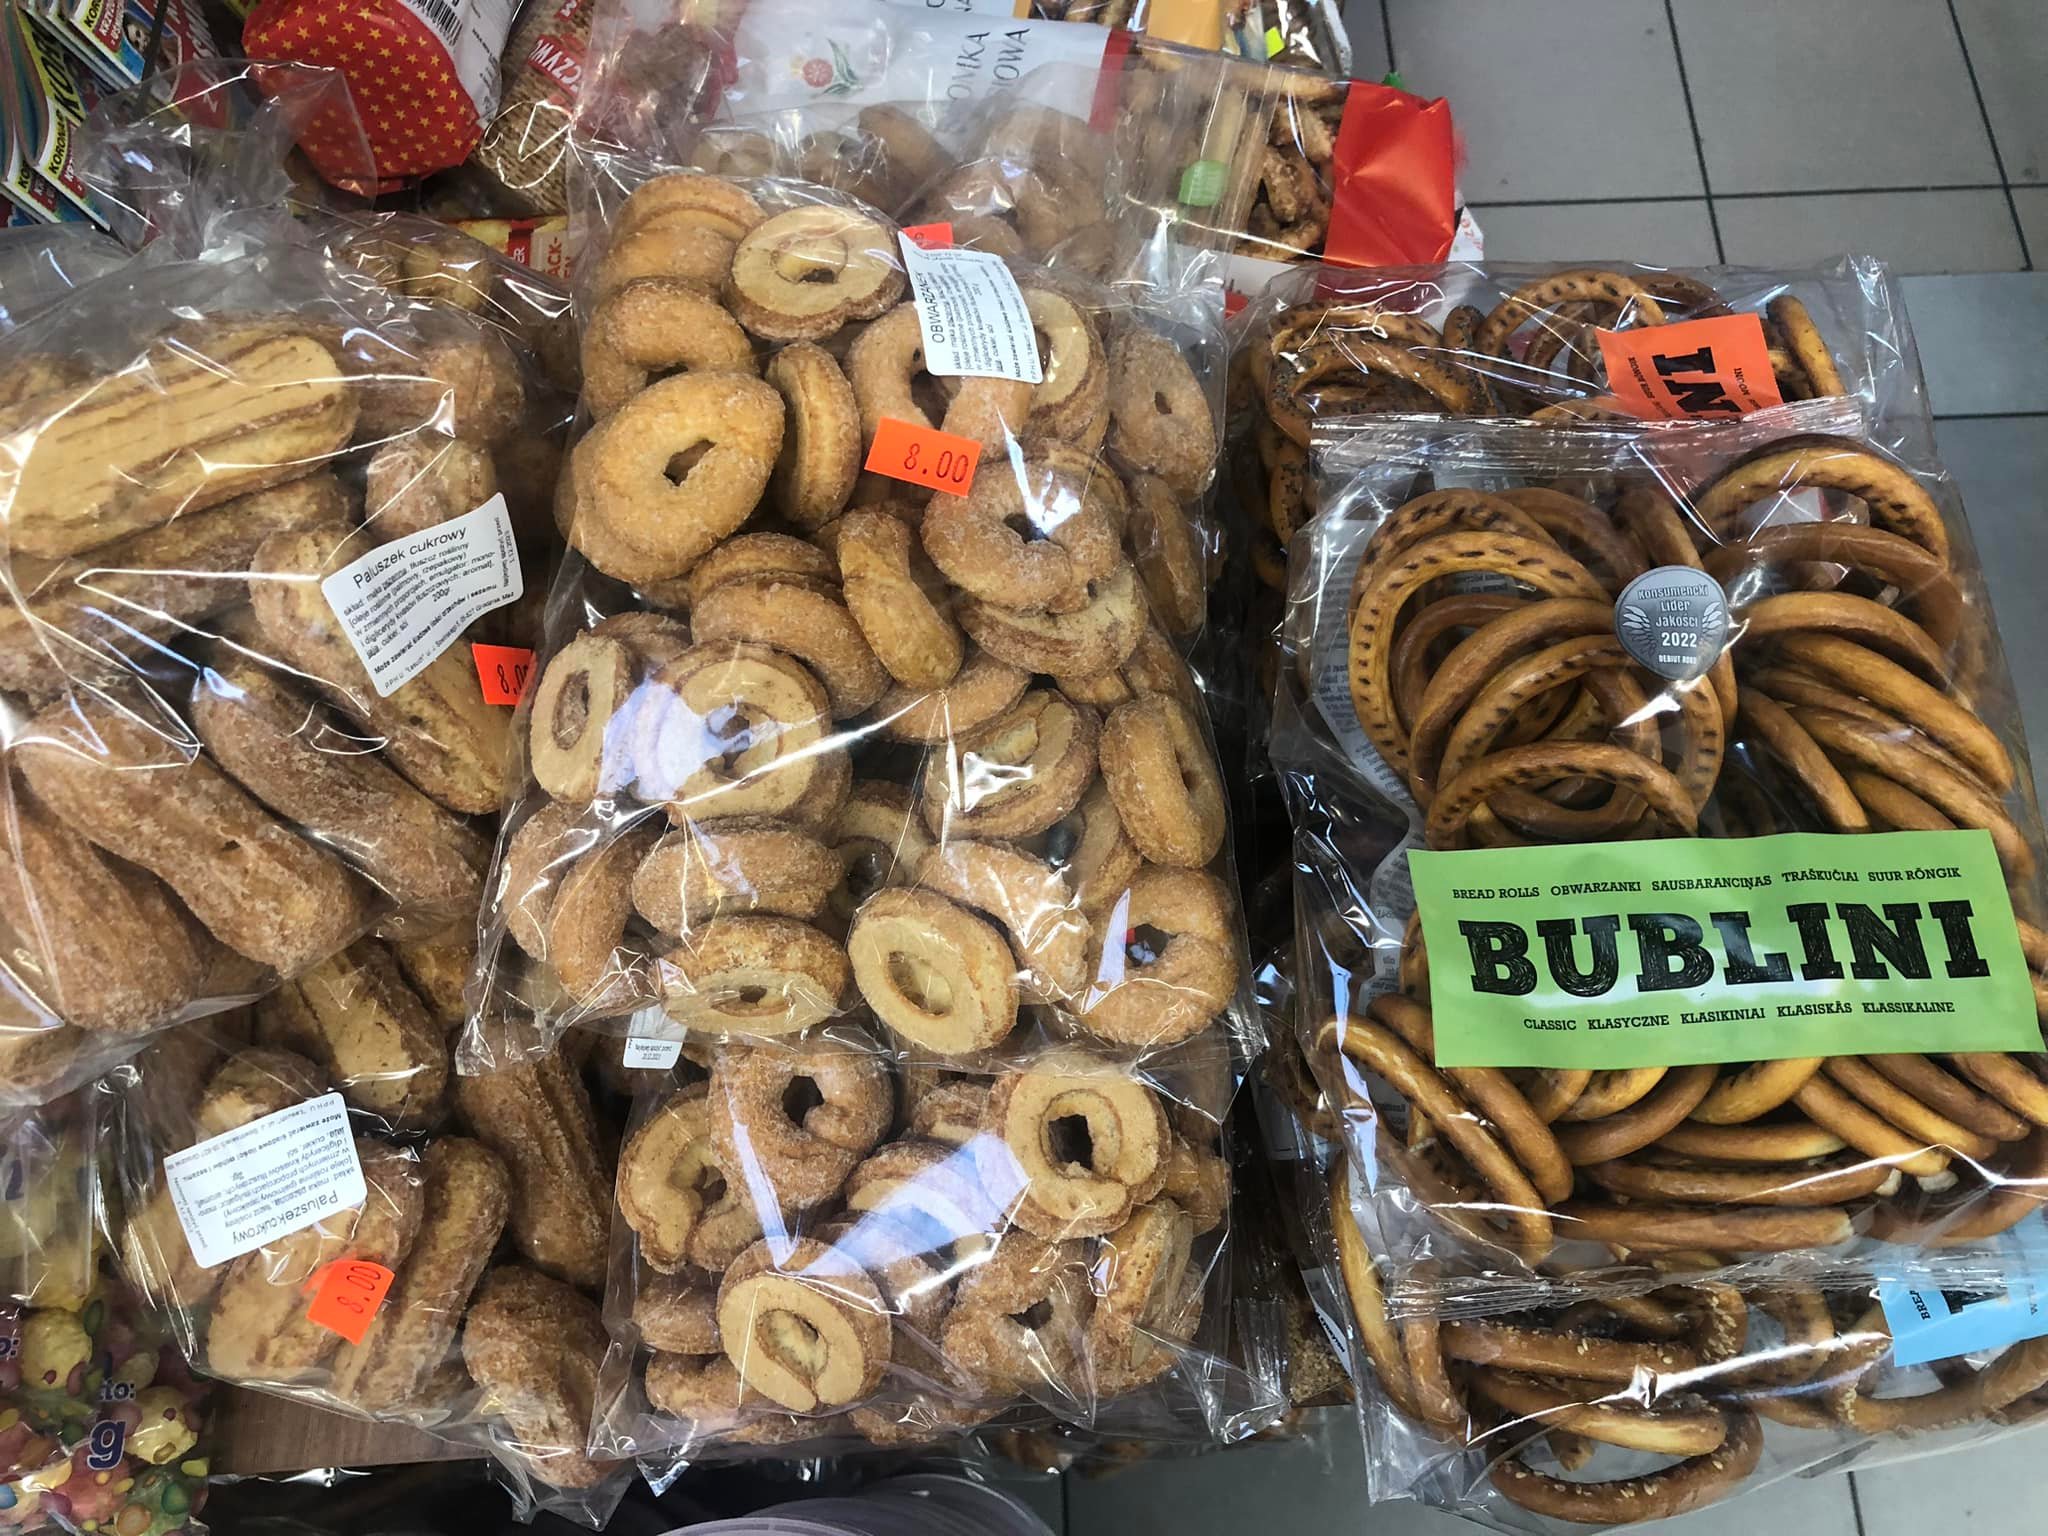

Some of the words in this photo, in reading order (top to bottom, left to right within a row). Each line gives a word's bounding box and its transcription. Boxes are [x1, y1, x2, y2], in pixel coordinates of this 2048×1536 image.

[904, 443, 969, 484] 8.00
[353, 549, 406, 589] Paluszek
[410, 527, 467, 555] cukrowy
[1661, 632, 1698, 648] 2022
[1452, 888, 1495, 900] BREAD
[1498, 886, 1541, 899] ROLLS
[1550, 881, 1642, 897] OBWARZANKI
[1781, 868, 1860, 883] TRAŠKUČIAI
[1868, 870, 1904, 882] SUUR
[1458, 900, 1991, 998] BUBLINI
[1523, 1017, 1577, 1031] CLASSIC
[1587, 1015, 1670, 1031] KLASYCZNE
[1680, 1007, 1766, 1025] KLASIKINIAI
[1862, 1001, 1956, 1014] KLASSIKALINE
[279, 1190, 338, 1225] Paluszek
[232, 1217, 278, 1244] cukrowy
[336, 1265, 381, 1314] 8.00
